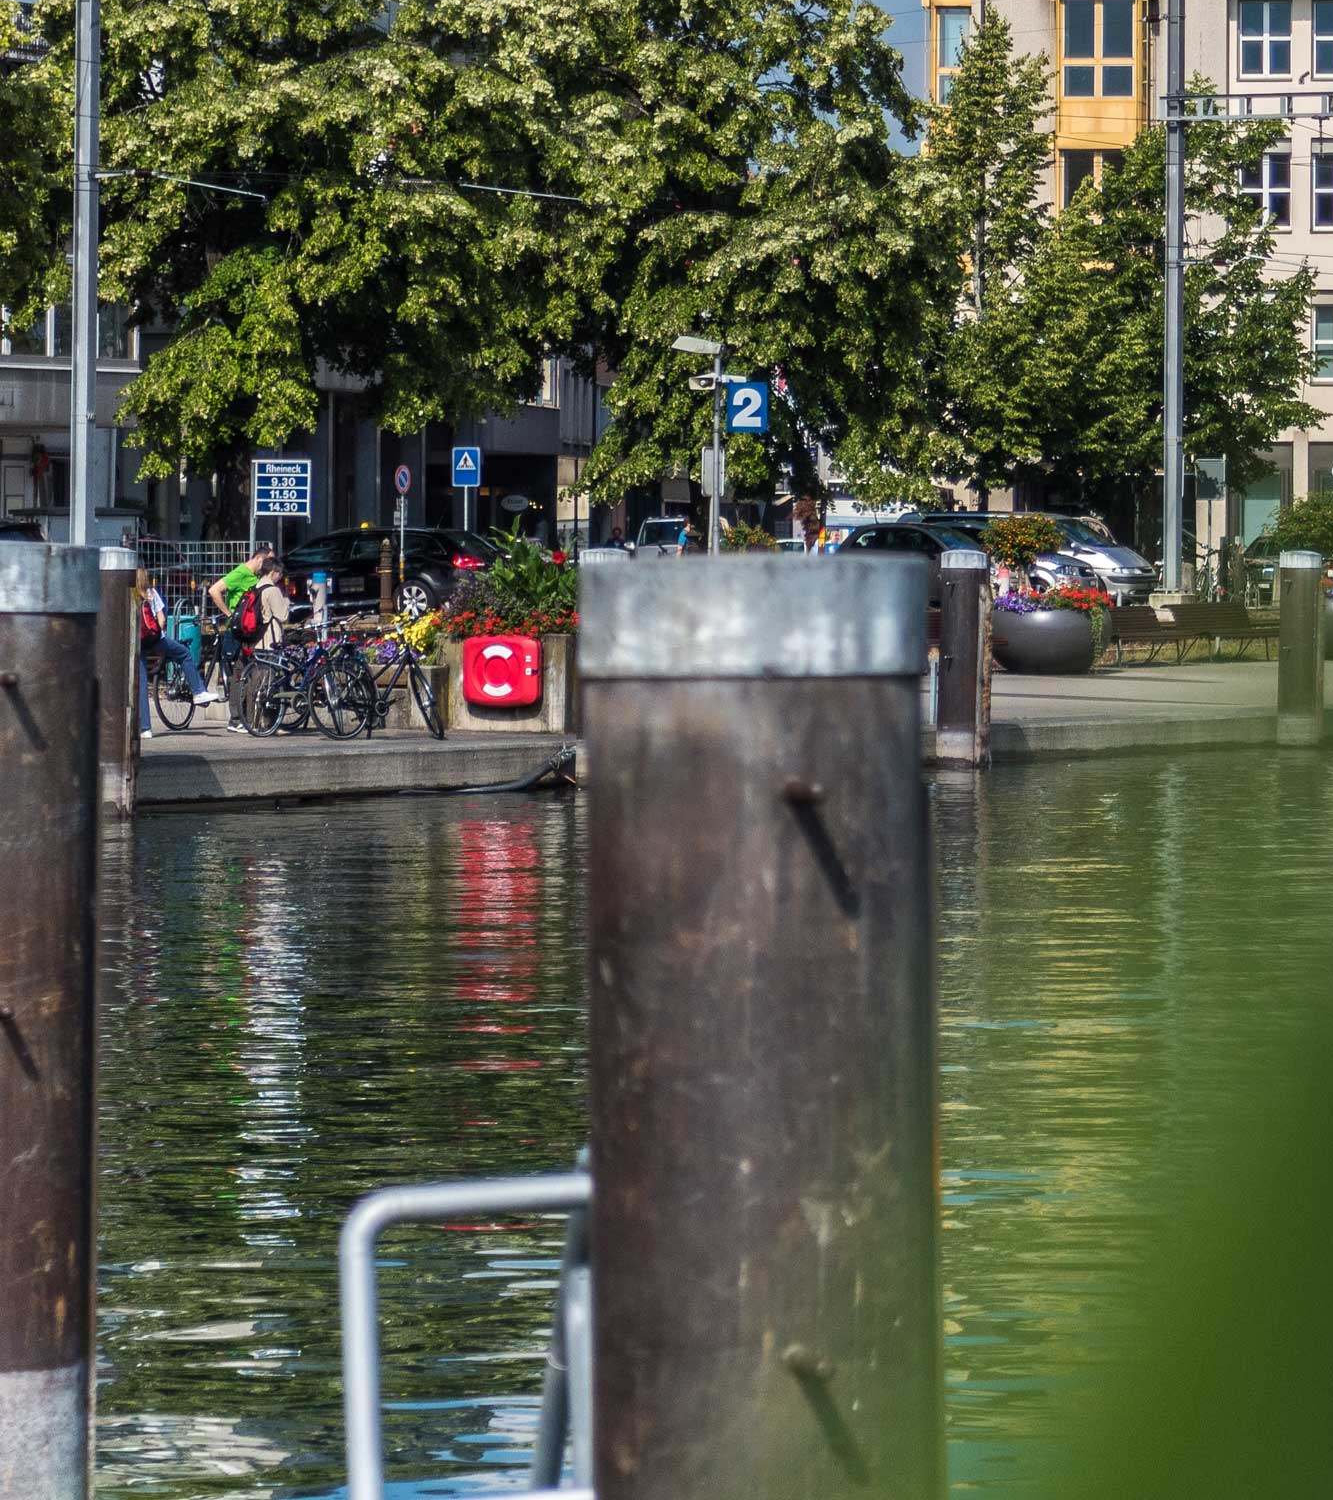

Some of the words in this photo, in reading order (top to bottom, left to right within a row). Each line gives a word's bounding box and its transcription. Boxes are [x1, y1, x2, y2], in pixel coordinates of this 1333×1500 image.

[731, 387, 762, 428] 2
[266, 464, 301, 473] Rheineck
[271, 477, 296, 486] 9.30
[269, 490, 298, 499] 11.50
[268, 502, 298, 512] 14.30
